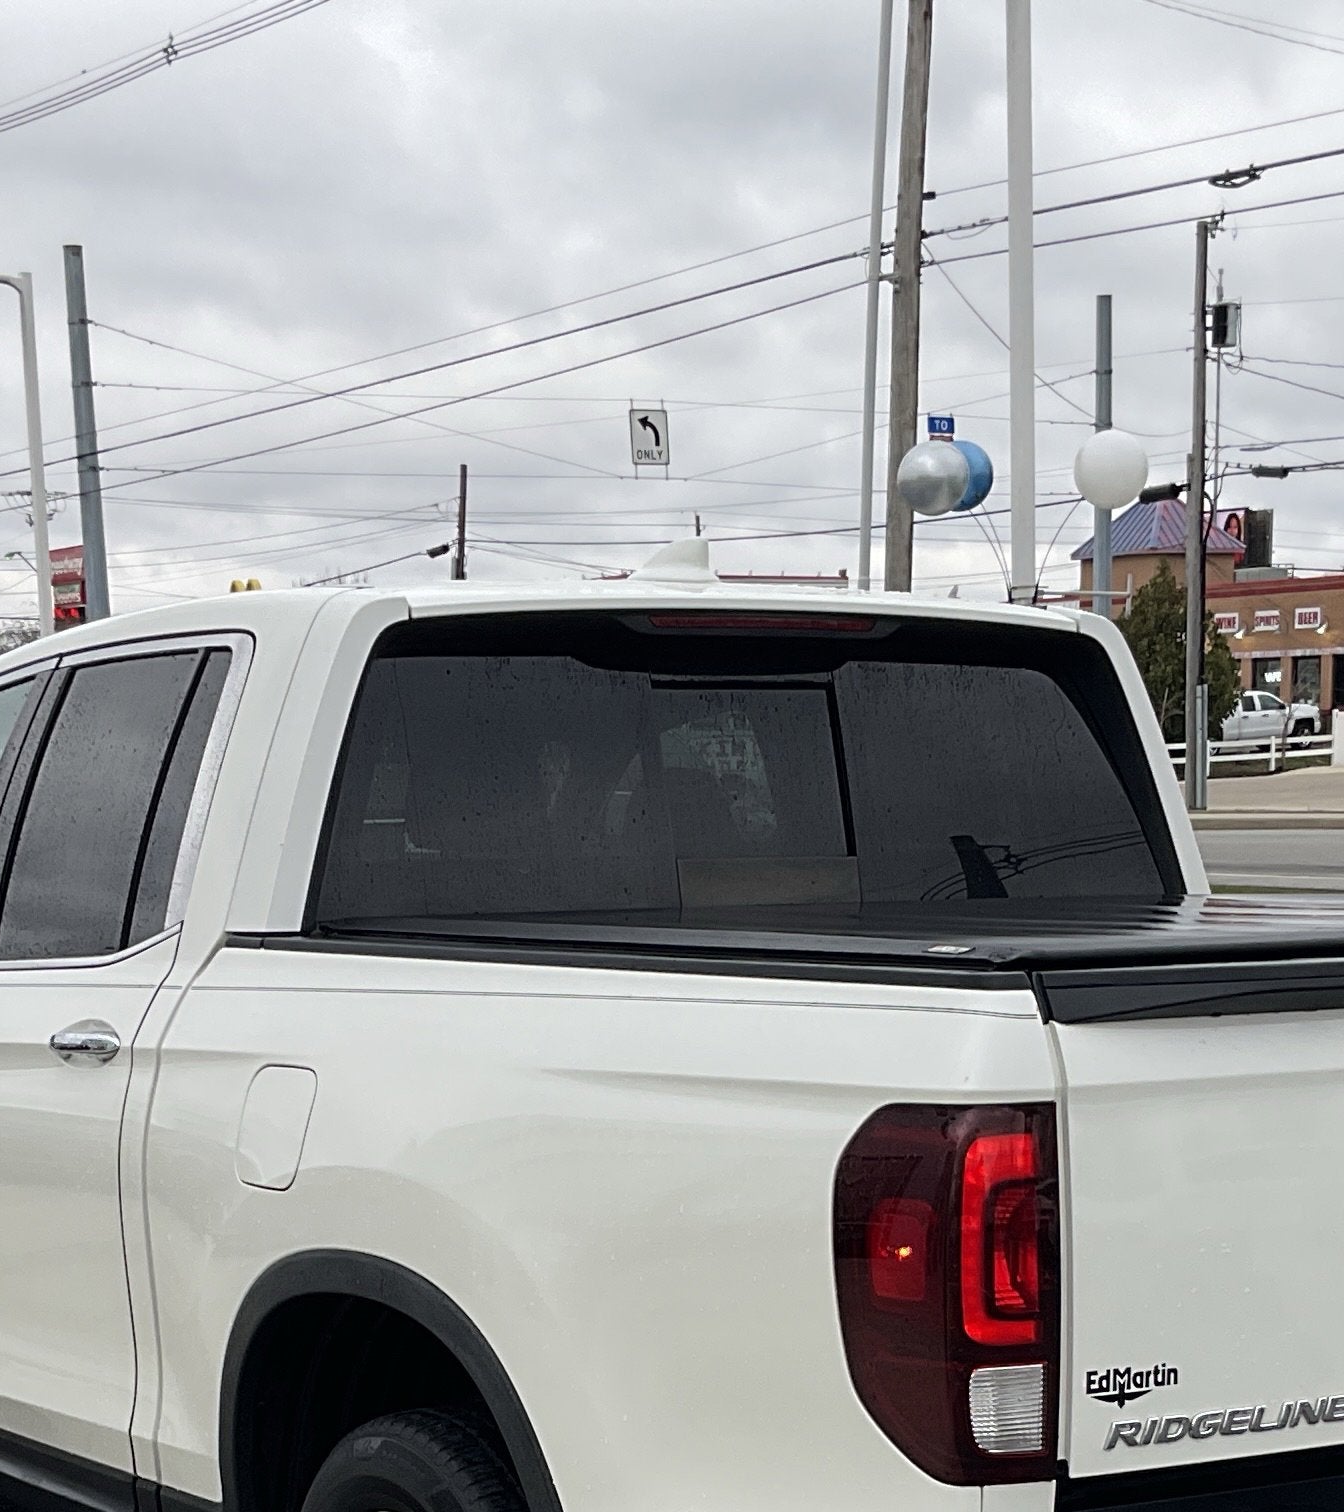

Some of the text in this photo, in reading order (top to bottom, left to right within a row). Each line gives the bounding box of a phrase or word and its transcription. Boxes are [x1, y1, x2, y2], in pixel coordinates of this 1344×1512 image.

[934, 420, 948, 431] TO
[636, 449, 663, 460] ONLY
[1297, 611, 1318, 625] BEER
